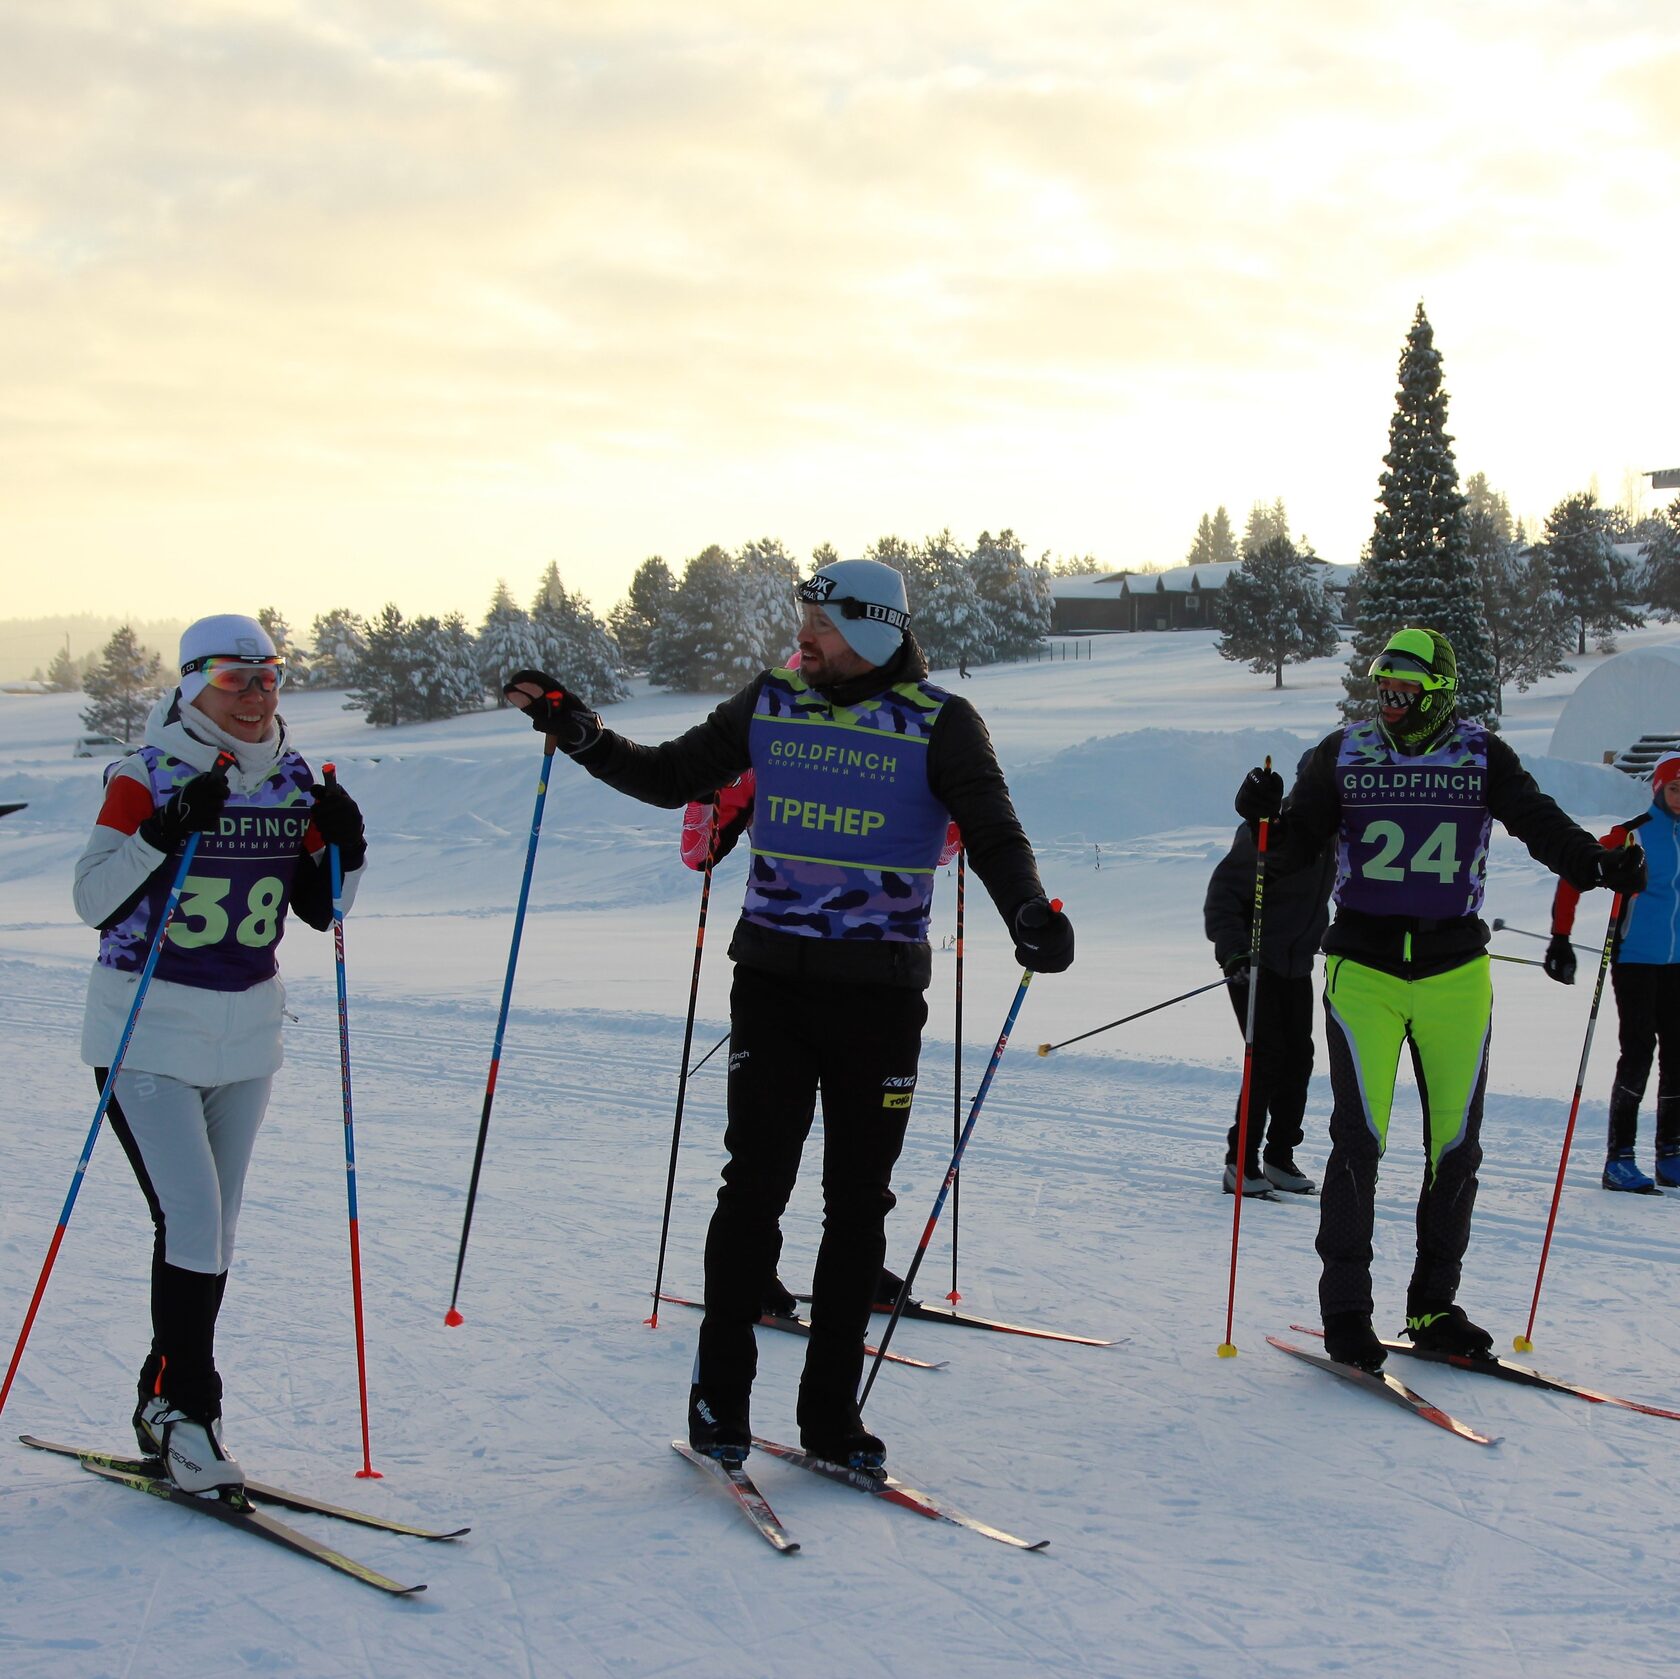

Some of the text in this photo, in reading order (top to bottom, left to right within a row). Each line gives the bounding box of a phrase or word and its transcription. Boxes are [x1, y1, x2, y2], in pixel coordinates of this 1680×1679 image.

[768, 759, 895, 783] СПОРТИВНЫЙ КЛУБ
[770, 740, 897, 773] GOLDFINCH
[1343, 773, 1481, 791] GOLDFINCH
[1343, 791, 1437, 799] СПОРТИВНЫЙ
[767, 795, 885, 836] ТРЕНЕР
[1360, 820, 1462, 884] 24
[1255, 874, 1264, 910] LEKI
[167, 875, 284, 949] 38
[1601, 938, 1613, 969] LEKI
